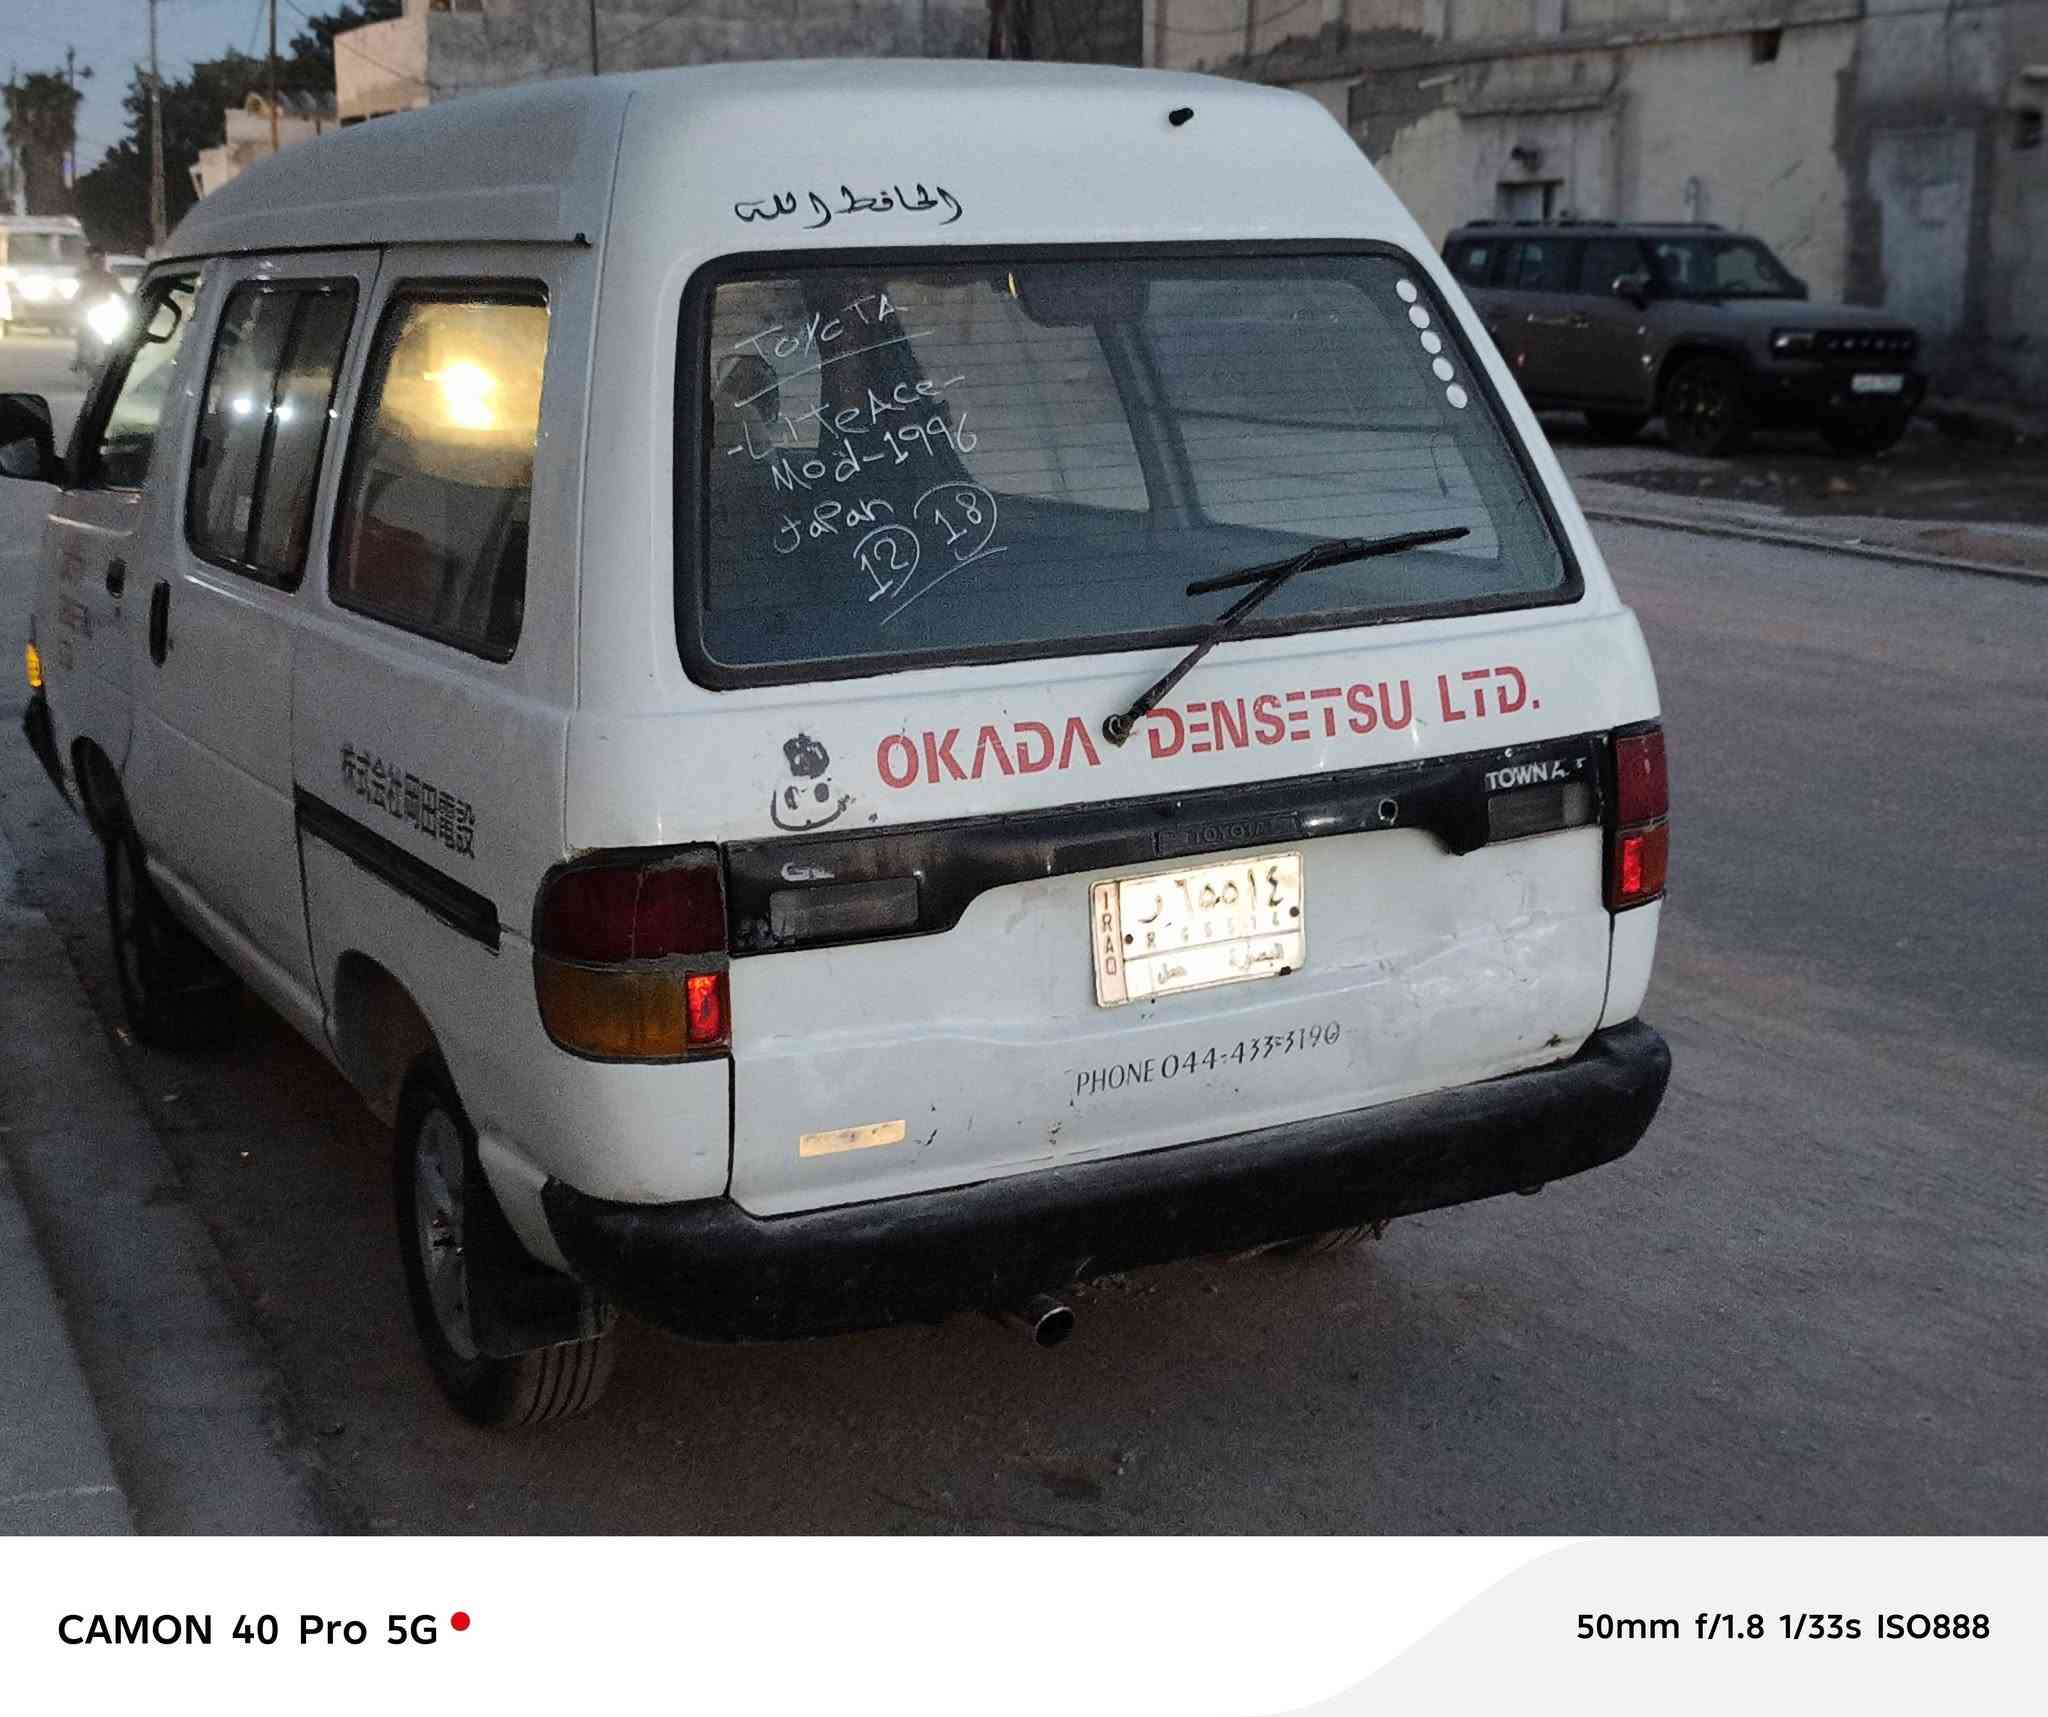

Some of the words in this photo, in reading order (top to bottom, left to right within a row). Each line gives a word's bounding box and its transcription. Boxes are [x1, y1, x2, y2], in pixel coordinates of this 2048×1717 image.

[861, 538, 909, 602] 12
[876, 716, 1102, 789] OKADA
[1145, 679, 1412, 760] DENSETSU
[1437, 665, 1541, 723] LTD.
[1485, 761, 1548, 790] TOWN
[1101, 891, 1118, 976] IRAQ
[1076, 1058, 1155, 1096] PHONE
